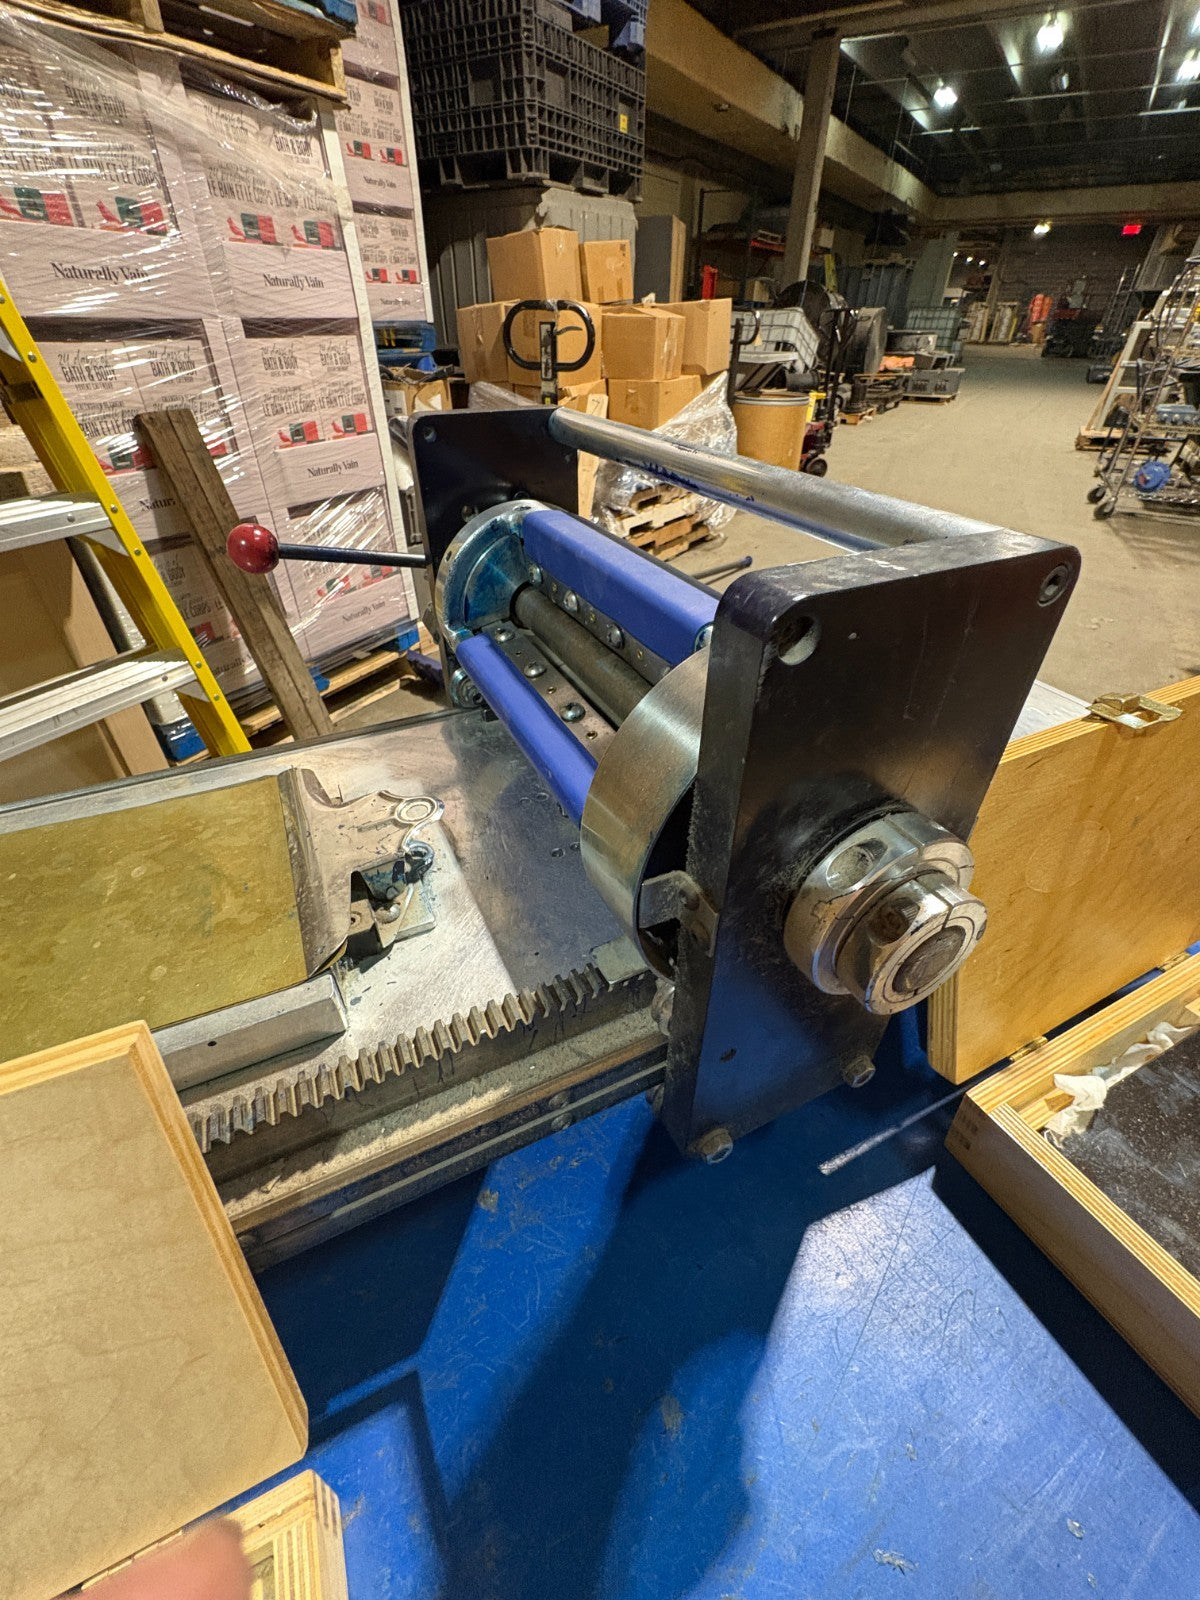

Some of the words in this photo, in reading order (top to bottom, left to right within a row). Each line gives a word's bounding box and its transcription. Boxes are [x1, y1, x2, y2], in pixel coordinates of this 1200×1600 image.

[50, 261, 120, 285] Naturally
[262, 273, 304, 291] Naturally
[304, 275, 325, 289] Vain
[61, 366, 86, 383] BATH
[94, 364, 117, 381] BODY
[150, 361, 171, 377] BATH
[307, 462, 342, 478] Naturally
[342, 459, 359, 470] Vain
